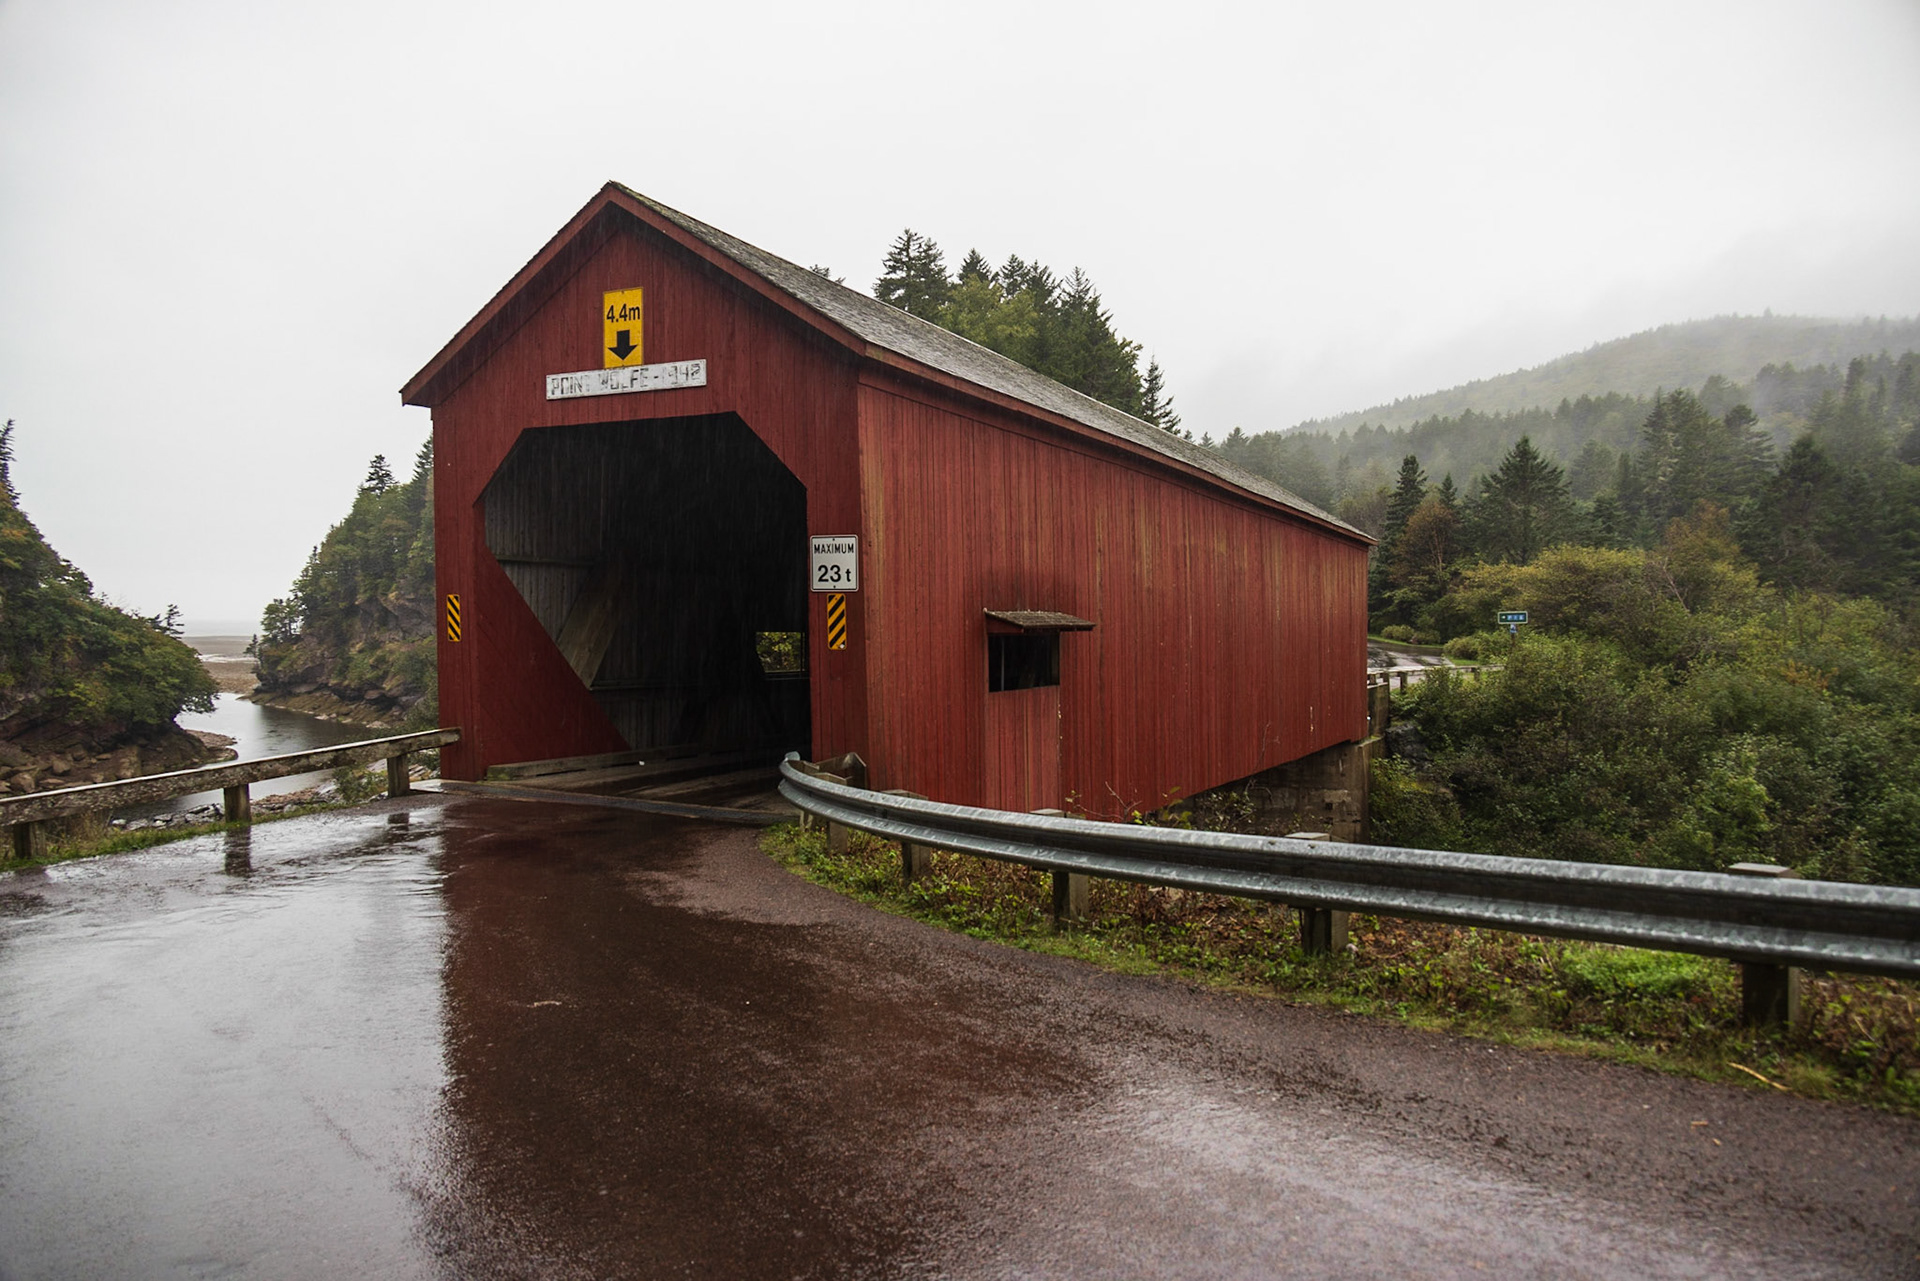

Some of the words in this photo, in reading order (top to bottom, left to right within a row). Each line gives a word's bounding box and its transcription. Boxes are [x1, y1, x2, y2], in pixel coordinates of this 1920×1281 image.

[606, 304, 641, 323] 4.4m
[814, 543, 854, 554] MAXIMUM
[818, 564, 841, 582] 23
